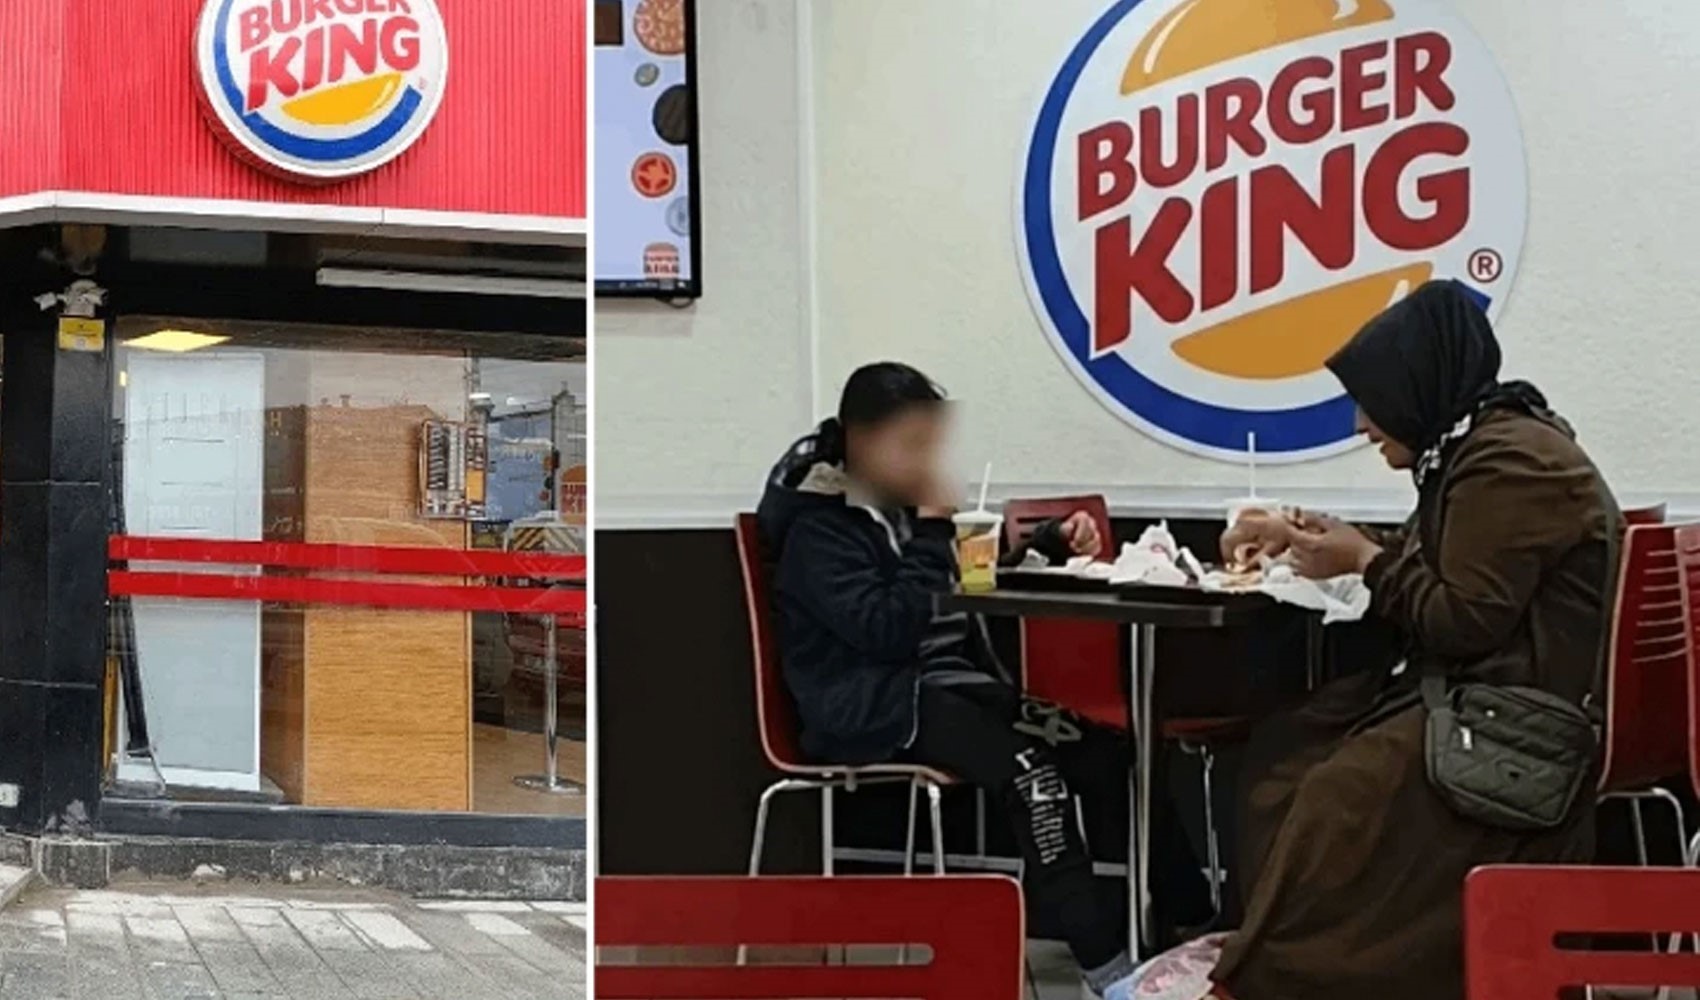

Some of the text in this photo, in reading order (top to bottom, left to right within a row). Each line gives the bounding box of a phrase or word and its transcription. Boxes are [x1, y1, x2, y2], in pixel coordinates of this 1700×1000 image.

[247, 16, 420, 111] KING
[1078, 31, 1456, 222] BURGER
[1095, 122, 1470, 352] KING
